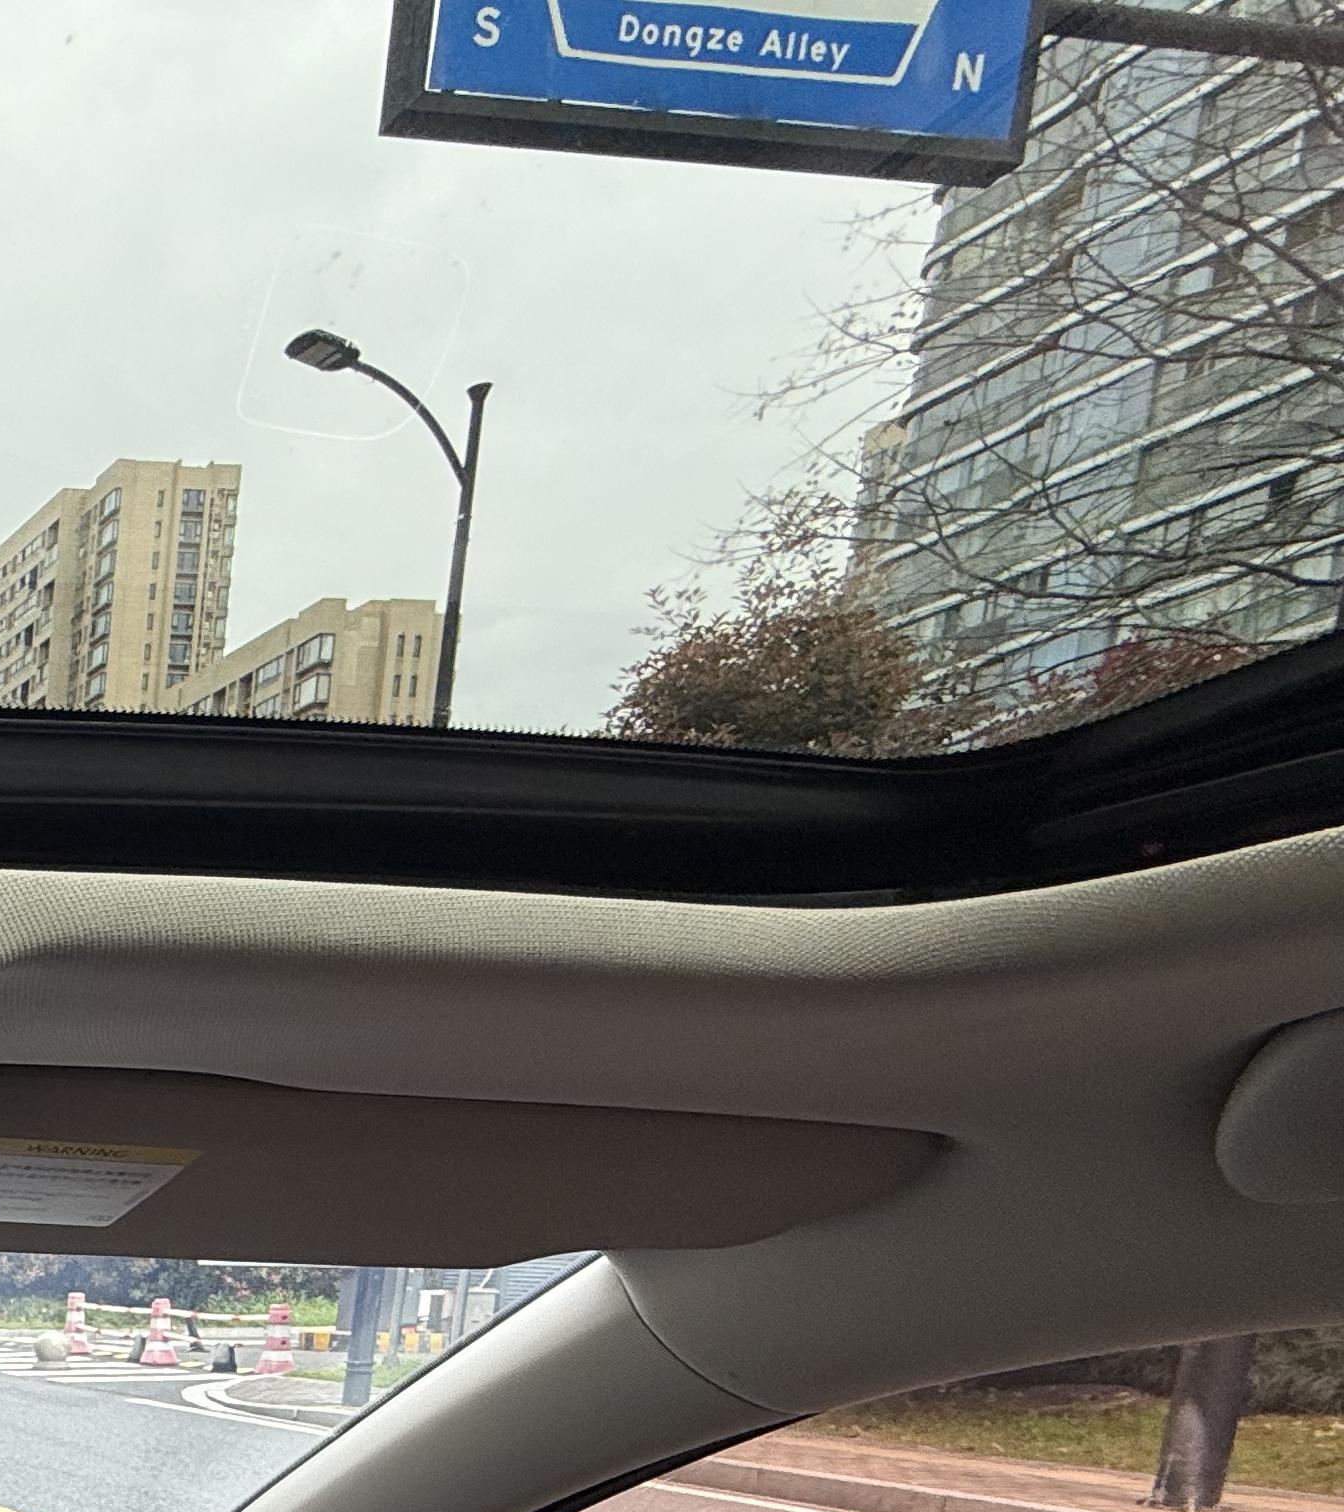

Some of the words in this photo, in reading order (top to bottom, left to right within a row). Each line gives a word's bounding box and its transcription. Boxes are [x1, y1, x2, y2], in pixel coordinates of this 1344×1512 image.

[472, 8, 500, 48] S
[618, 14, 744, 59] Dongze
[759, 30, 850, 72] Alley
[953, 52, 986, 93] N
[27, 1144, 126, 1158] WARNING
